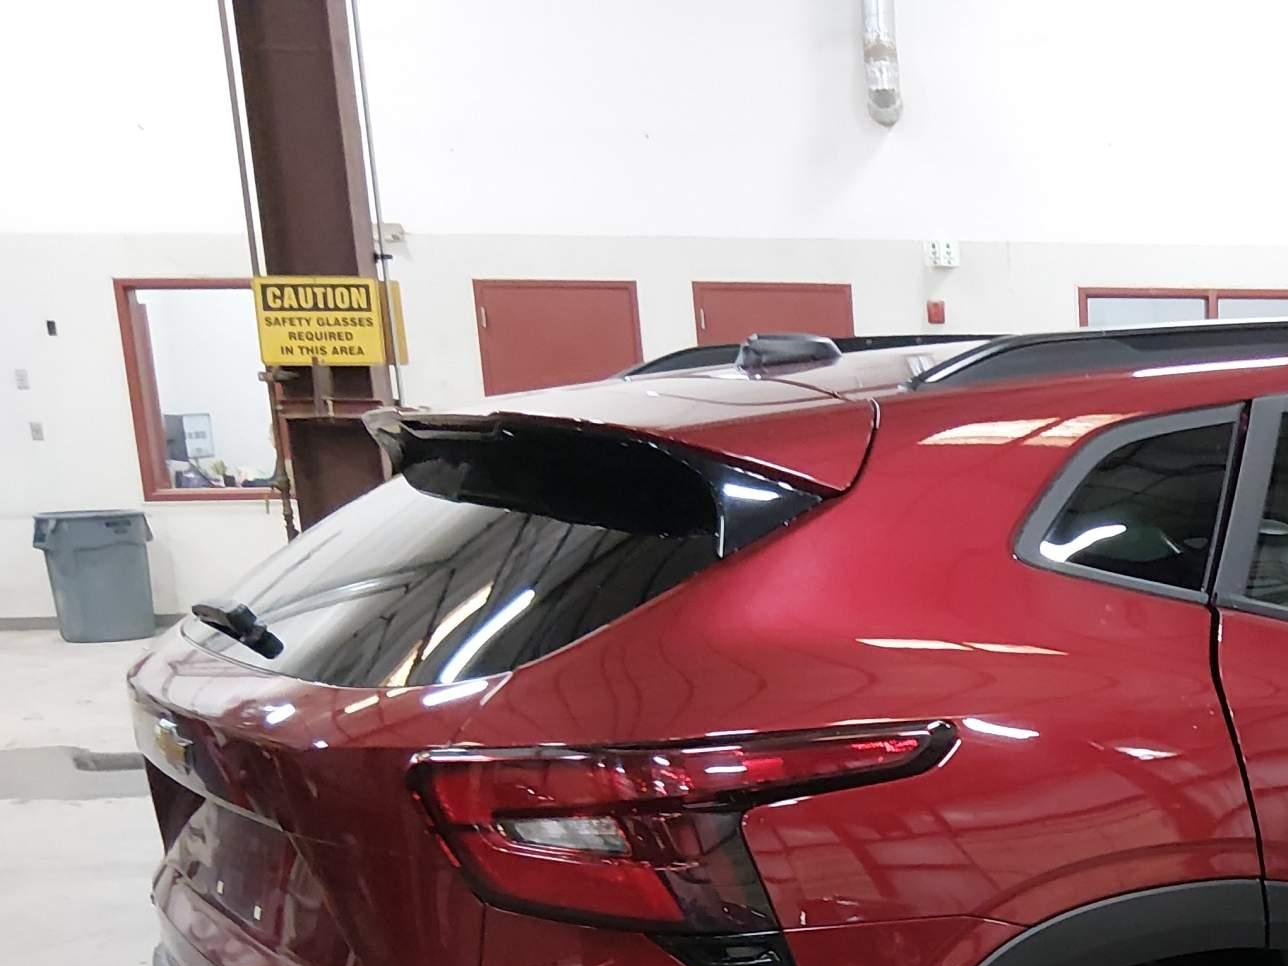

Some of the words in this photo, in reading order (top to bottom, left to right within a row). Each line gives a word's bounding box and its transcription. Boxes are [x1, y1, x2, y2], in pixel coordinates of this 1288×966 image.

[266, 286, 368, 309] CAUTION
[264, 316, 312, 327] SAFETY
[316, 317, 374, 327] GLASSES
[288, 331, 354, 342] REQUIRED
[280, 345, 294, 355] IN
[298, 345, 328, 356] THIS
[331, 346, 365, 356] AREA
